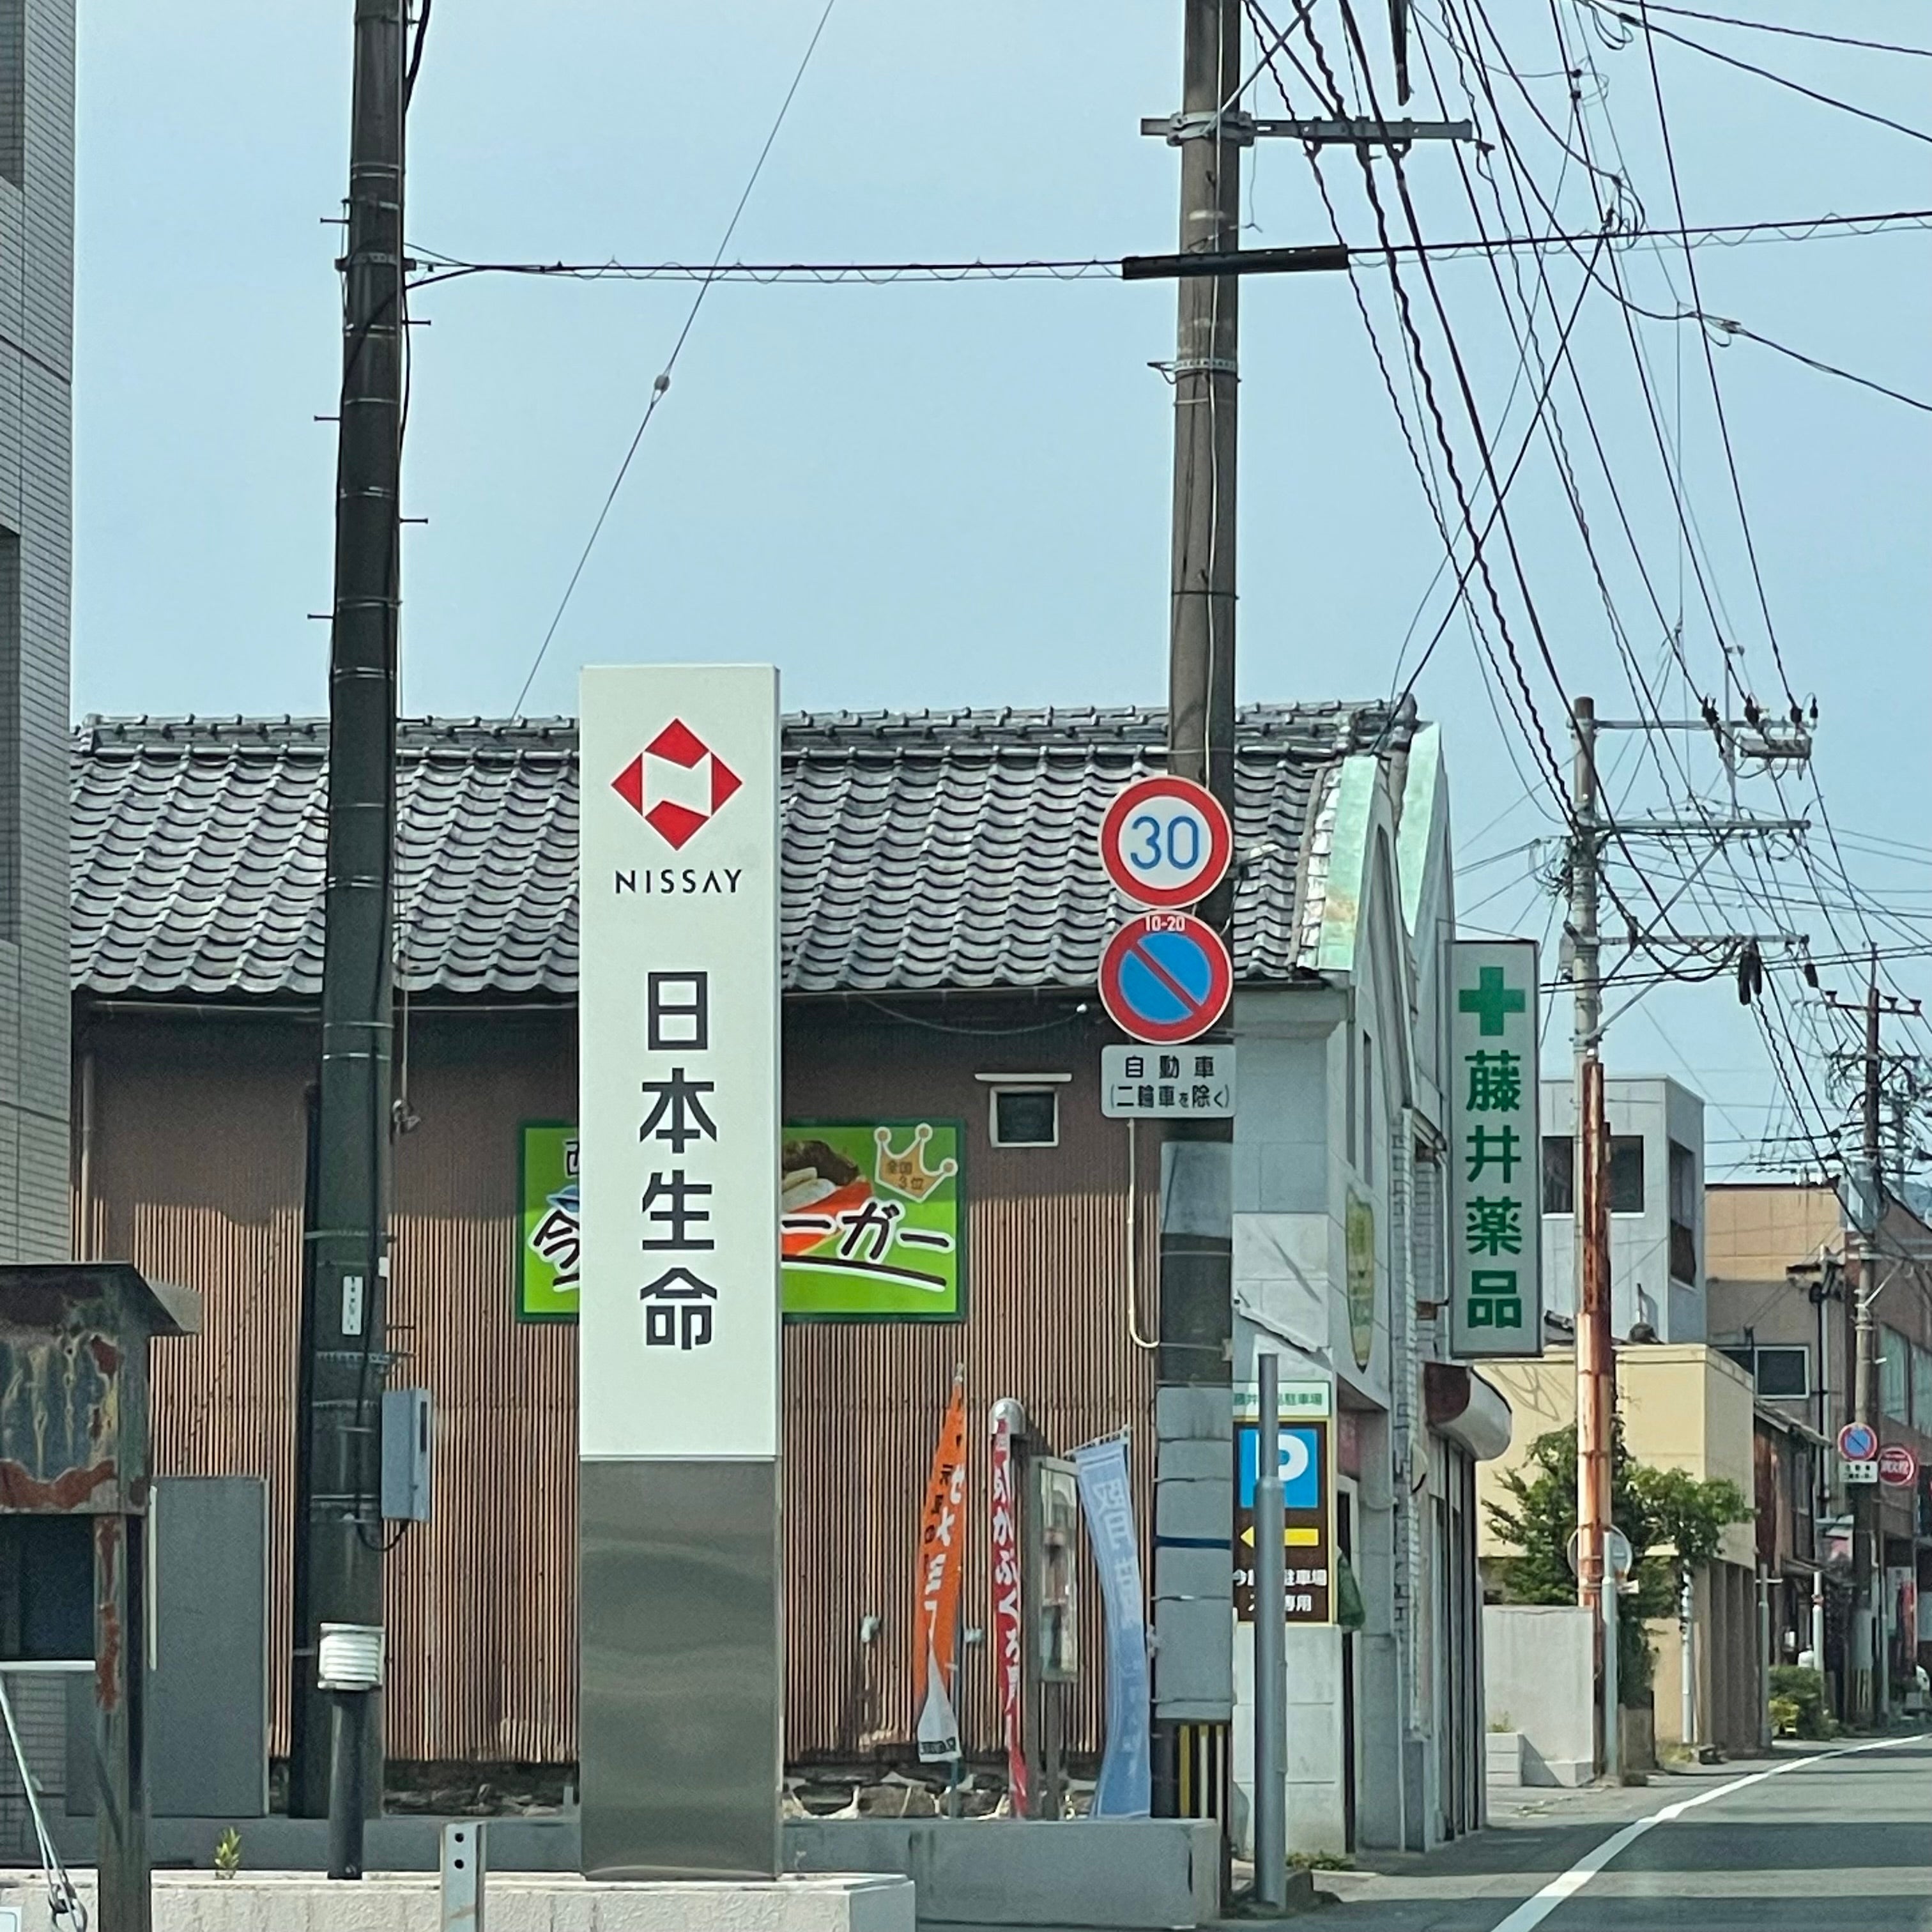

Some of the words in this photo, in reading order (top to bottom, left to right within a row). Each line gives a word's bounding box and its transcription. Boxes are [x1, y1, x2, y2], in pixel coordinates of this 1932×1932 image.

[1131, 816, 1199, 870] 30
[615, 869, 742, 894] NISSAY
[1145, 916, 1186, 932] 10-20
[1125, 1055, 1215, 1079] 自動車
[640, 971, 717, 1350] 日本生命
[1464, 1049, 1522, 1329] 藤井薬品
